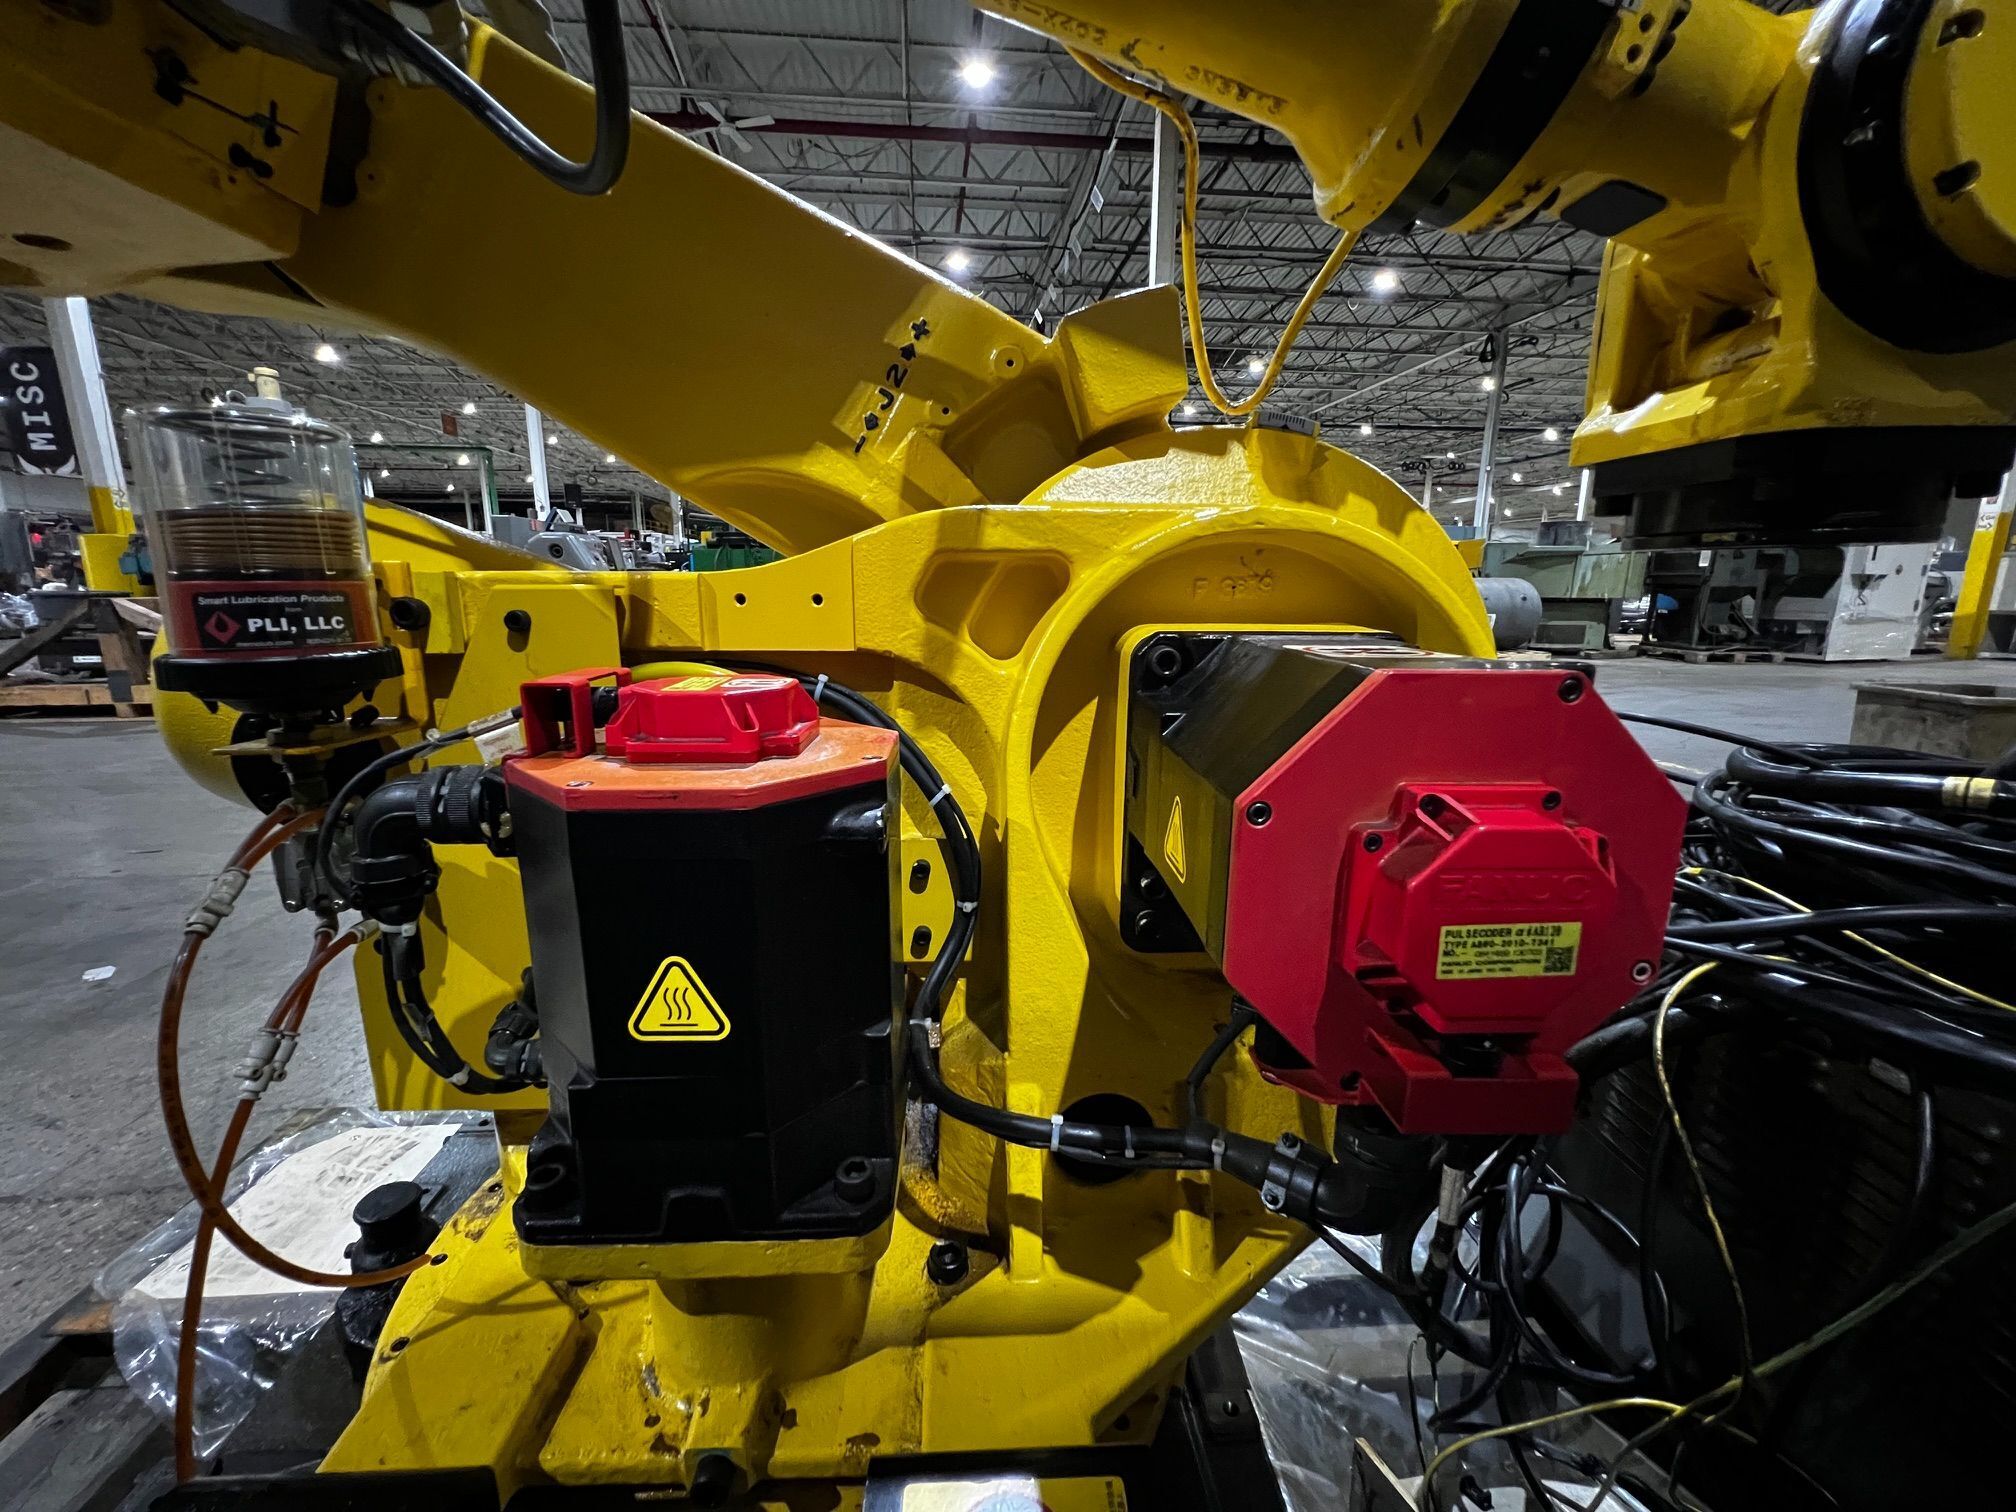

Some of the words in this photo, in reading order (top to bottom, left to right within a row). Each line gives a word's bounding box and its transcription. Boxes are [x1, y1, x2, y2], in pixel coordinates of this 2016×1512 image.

[877, 363, 909, 411] J2
[10, 361, 57, 451] MISC
[198, 596, 229, 606] Smart
[231, 595, 297, 604] Lubrication
[301, 594, 344, 603] Products
[247, 617, 298, 634] PLI,
[304, 616, 345, 630] LLC
[1444, 940, 1467, 949] TYPE
